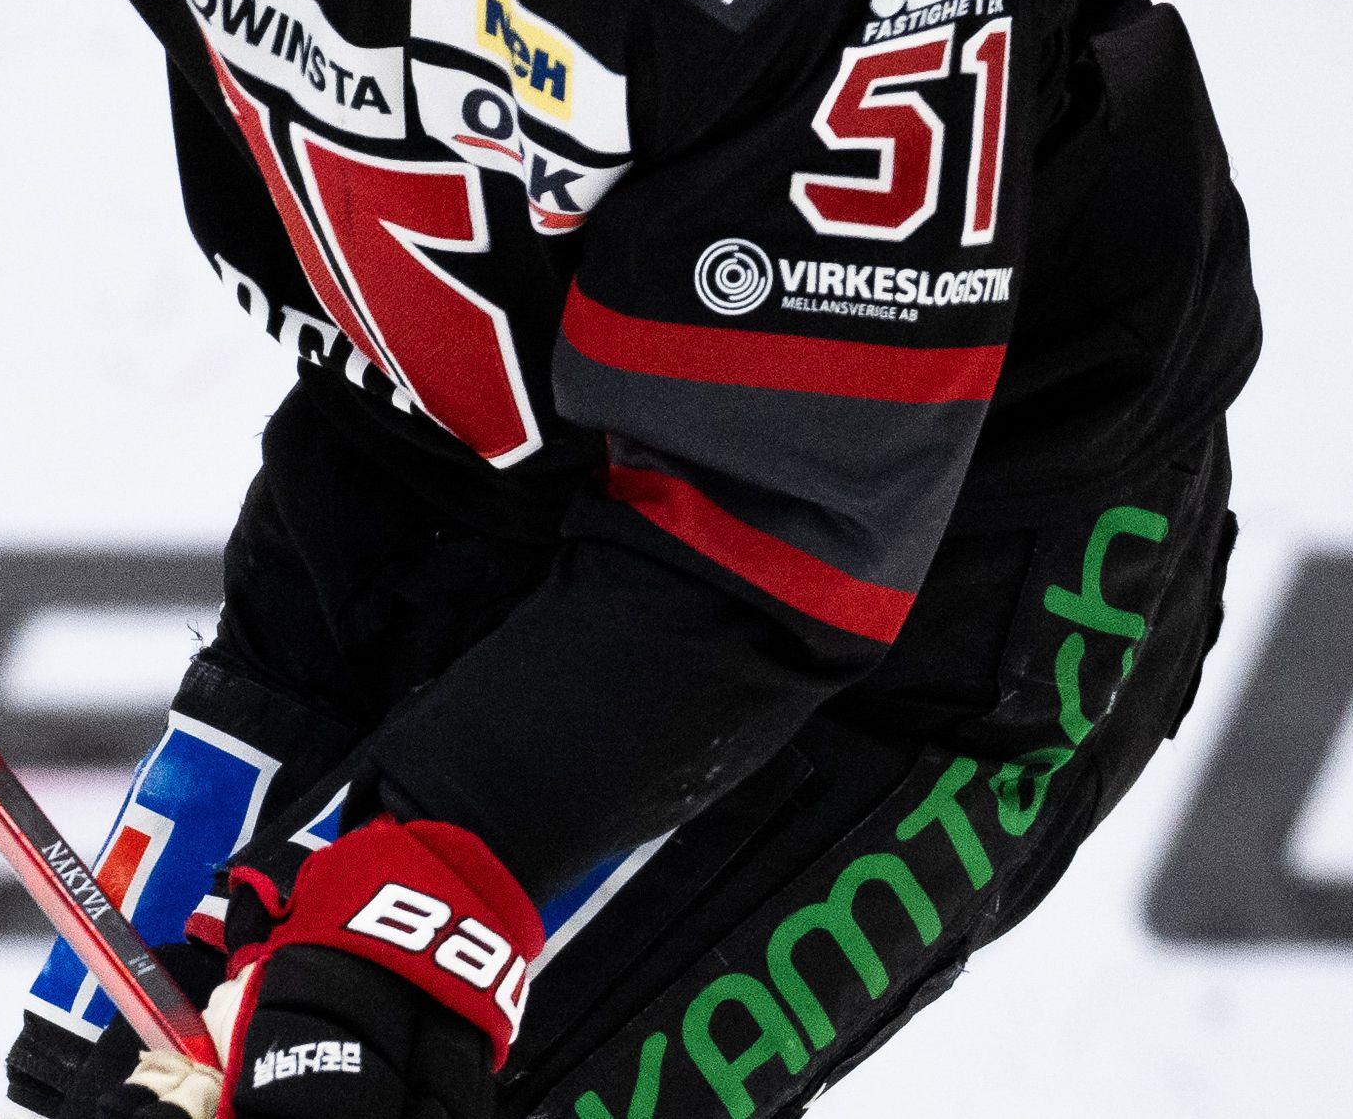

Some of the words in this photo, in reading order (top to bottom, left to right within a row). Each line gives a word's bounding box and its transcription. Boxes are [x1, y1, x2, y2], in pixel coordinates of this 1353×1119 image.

[789, 16, 1013, 247] 51
[777, 258, 1014, 306] VIRKESLOGISTIK
[781, 295, 897, 319] MELLANSVERIGE
[898, 306, 920, 322] AB
